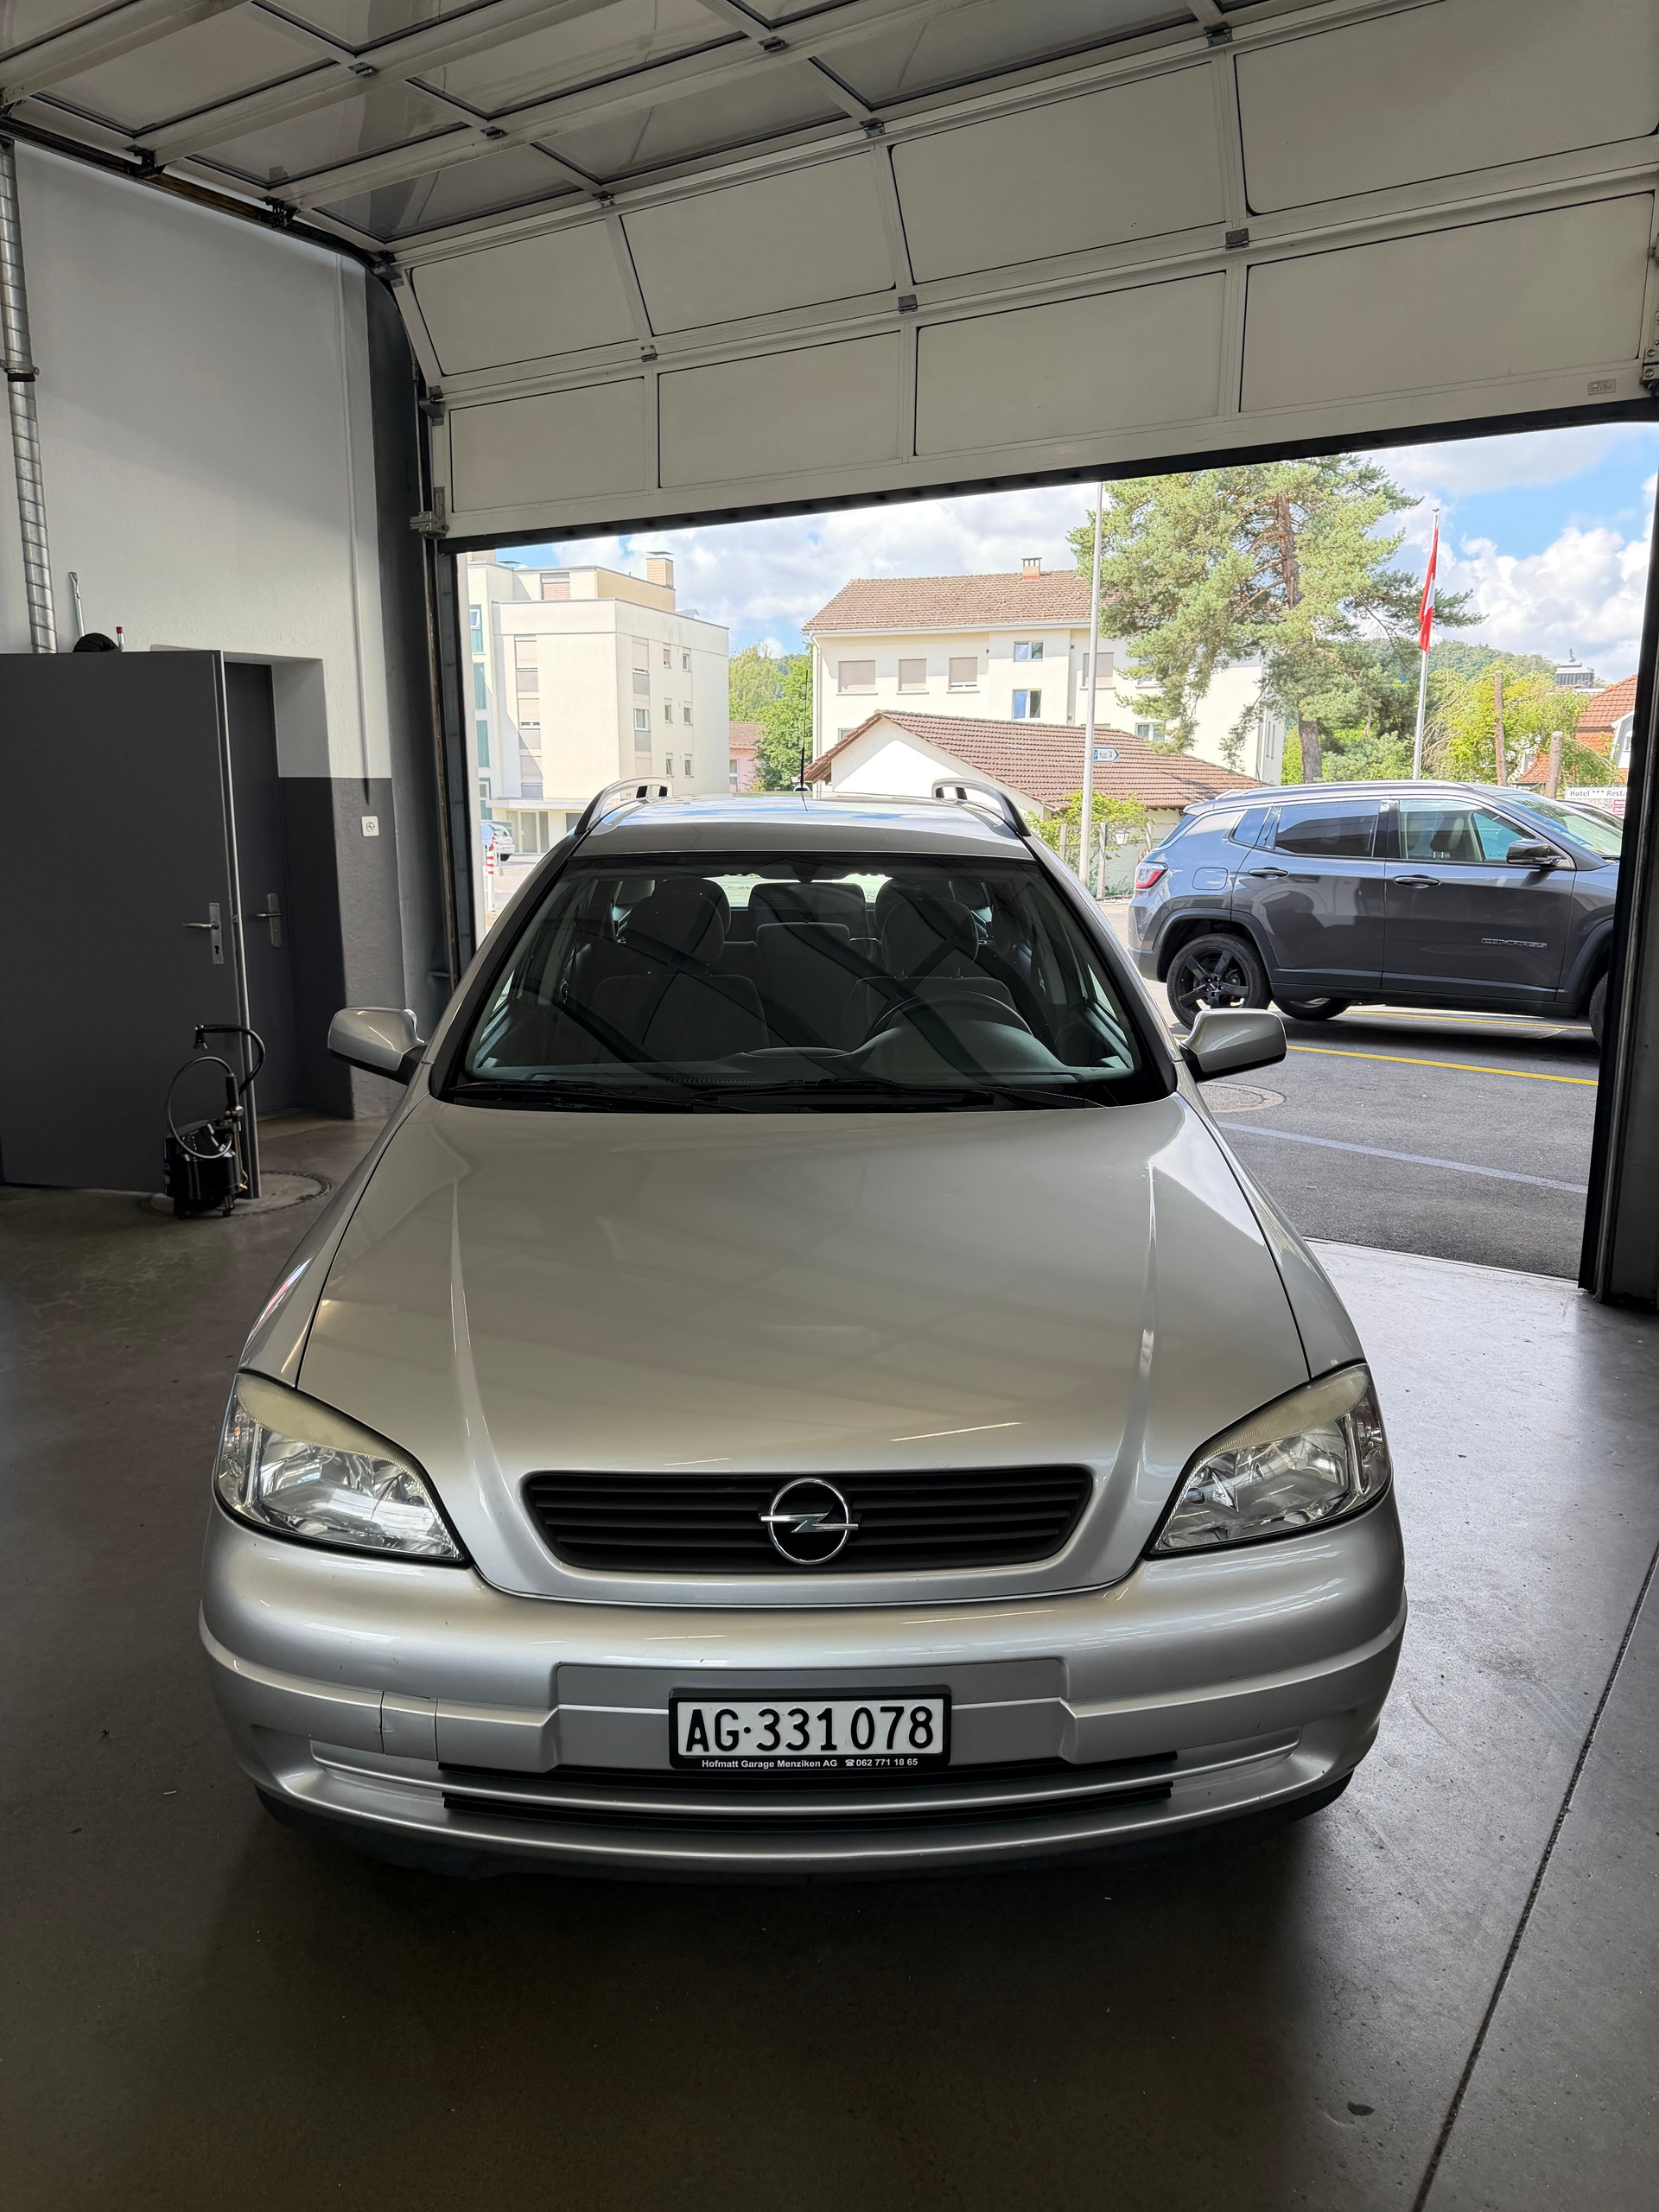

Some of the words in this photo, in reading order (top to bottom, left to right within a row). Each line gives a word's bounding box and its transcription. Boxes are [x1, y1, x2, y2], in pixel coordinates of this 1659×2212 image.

[702, 1759, 739, 1768] Hofmatt
[741, 1759, 775, 1770] Garage
[777, 1758, 821, 1768] Menziken
[823, 1759, 838, 1768] AG
[855, 1758, 873, 1767] 062
[874, 1758, 891, 1767] 771
[893, 1758, 905, 1767] 18
[906, 1758, 918, 1766] 65
